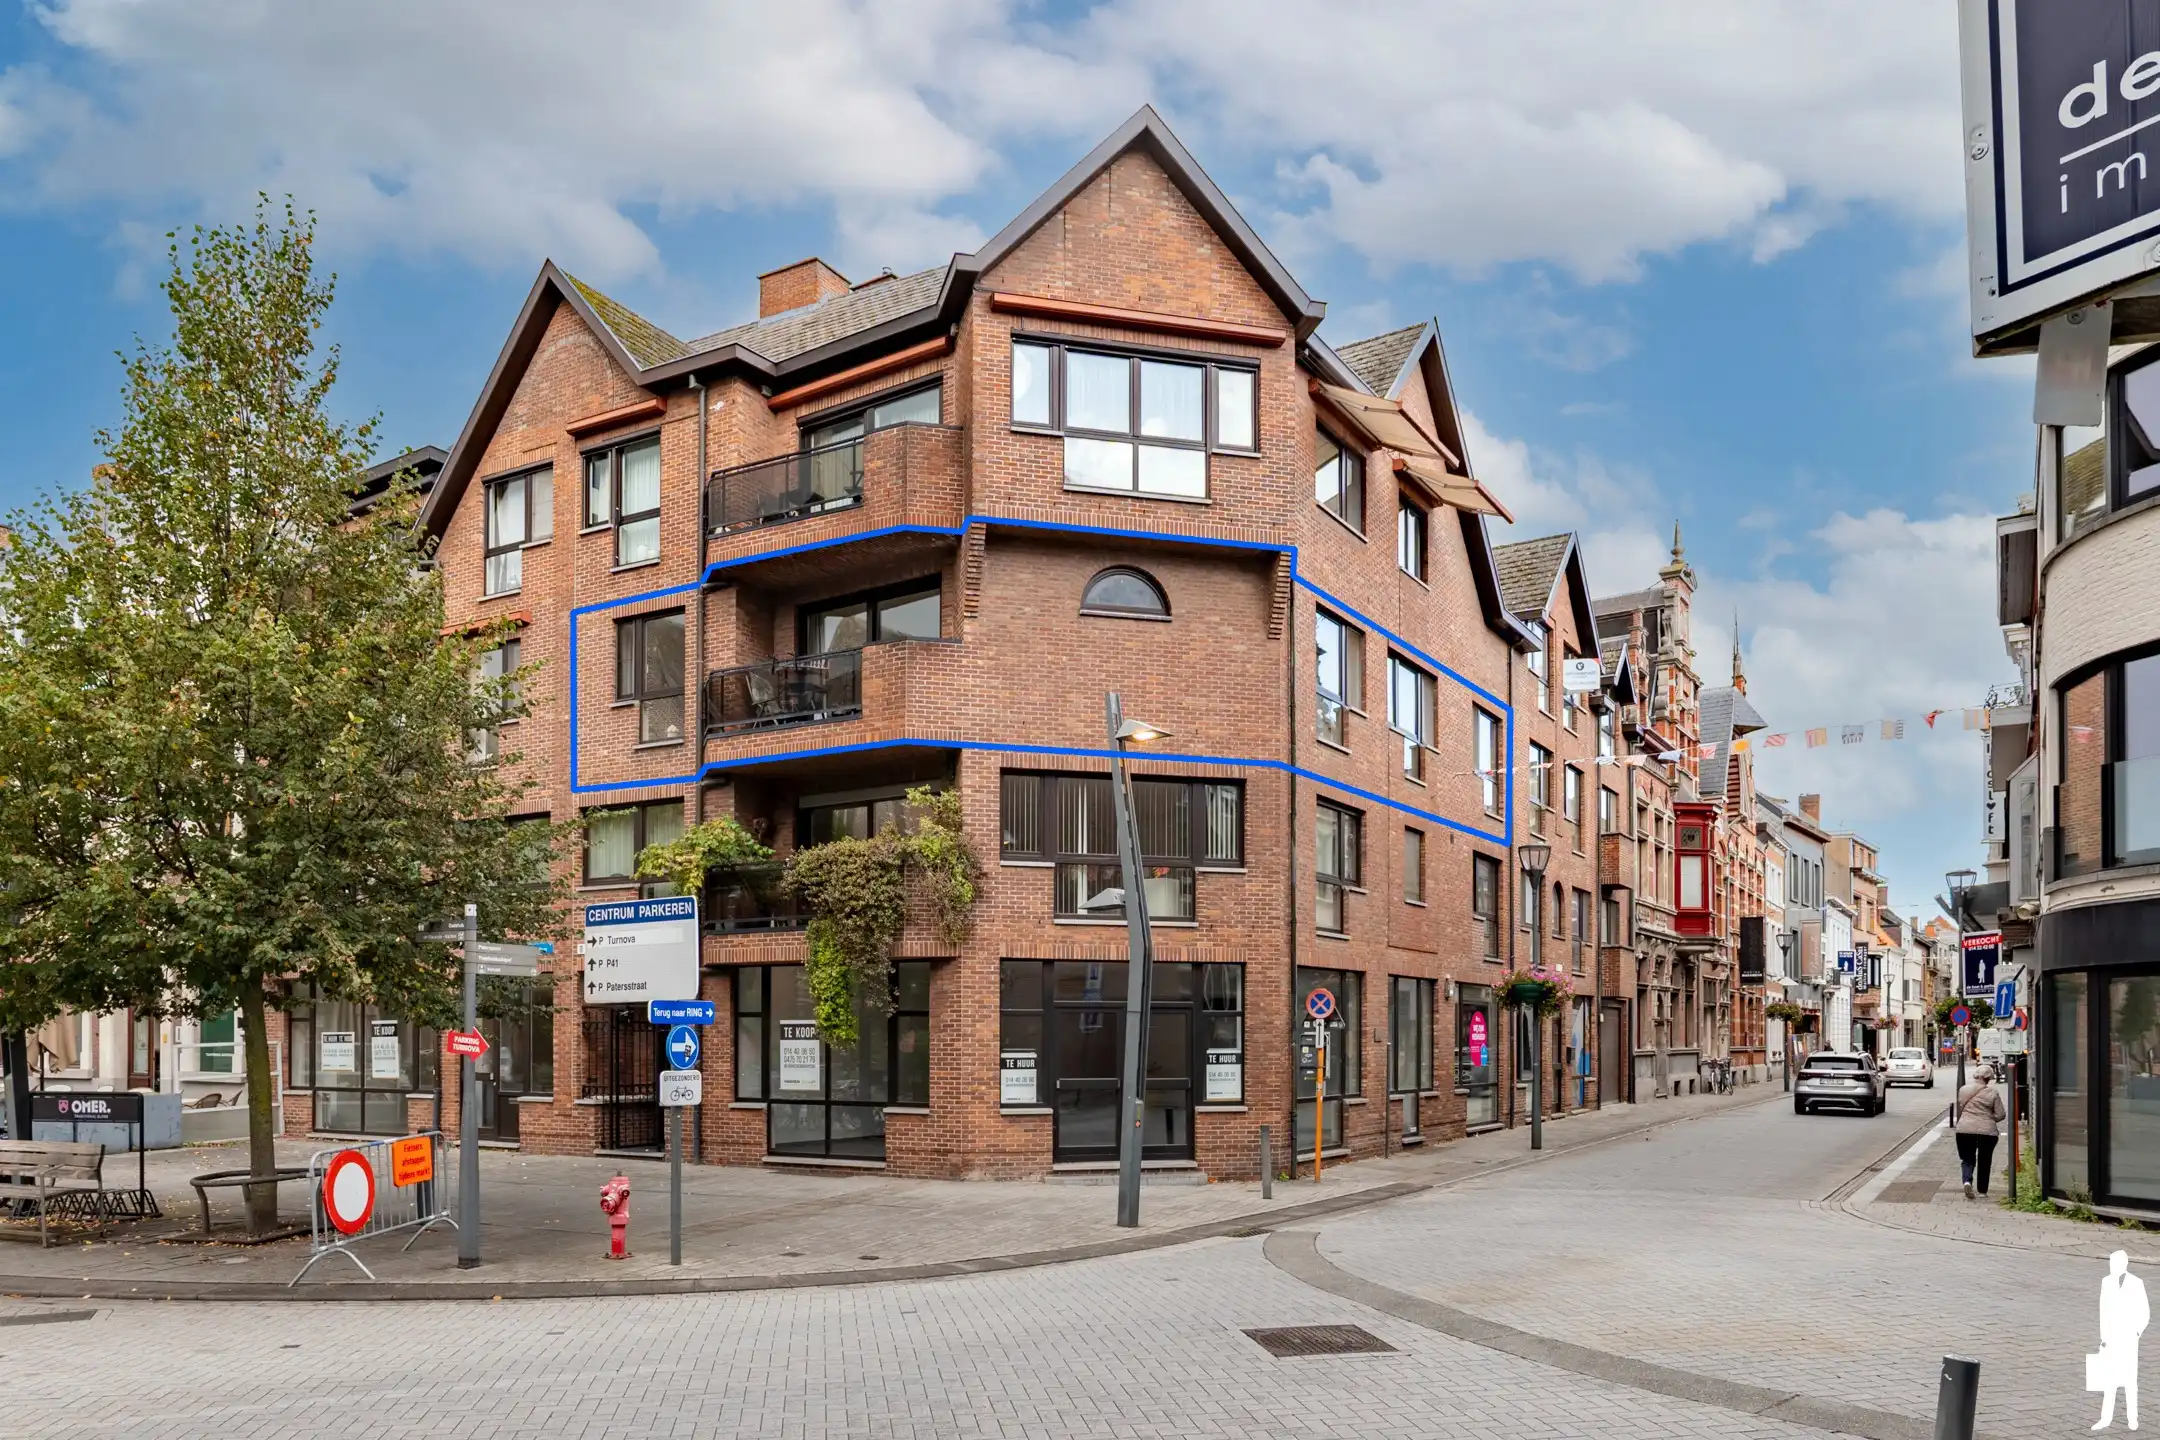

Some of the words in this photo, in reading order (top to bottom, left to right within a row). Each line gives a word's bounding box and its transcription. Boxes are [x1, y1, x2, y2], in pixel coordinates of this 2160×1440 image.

[2058, 50, 2160, 129] de
[2059, 151, 2148, 214] im
[588, 906, 635, 922] CENTRUM
[639, 902, 692, 918] PARKEREN
[598, 936, 604, 945] P
[607, 935, 636, 945] Turnova
[1963, 935, 2000, 947] VERKOCHT
[598, 959, 604, 968] P
[606, 958, 619, 968] P41
[598, 982, 604, 991] P
[606, 981, 647, 991] Patersstraat
[653, 1007, 671, 1018] Terug
[671, 1009, 686, 1017] naar
[686, 1007, 703, 1018] RING
[373, 1025, 380, 1036] TE
[381, 1025, 395, 1036] KOOP
[784, 1027, 793, 1038] TE
[795, 1026, 816, 1038] KOOP
[454, 1036, 480, 1045] PARKING
[453, 1043, 481, 1053] TURNOVA
[1006, 1059, 1015, 1068] TE
[1017, 1059, 1035, 1068] HUUR
[1208, 1055, 1217, 1063] TE
[1219, 1055, 1237, 1063] HUUR
[663, 1074, 700, 1082] UITGEZONDERD
